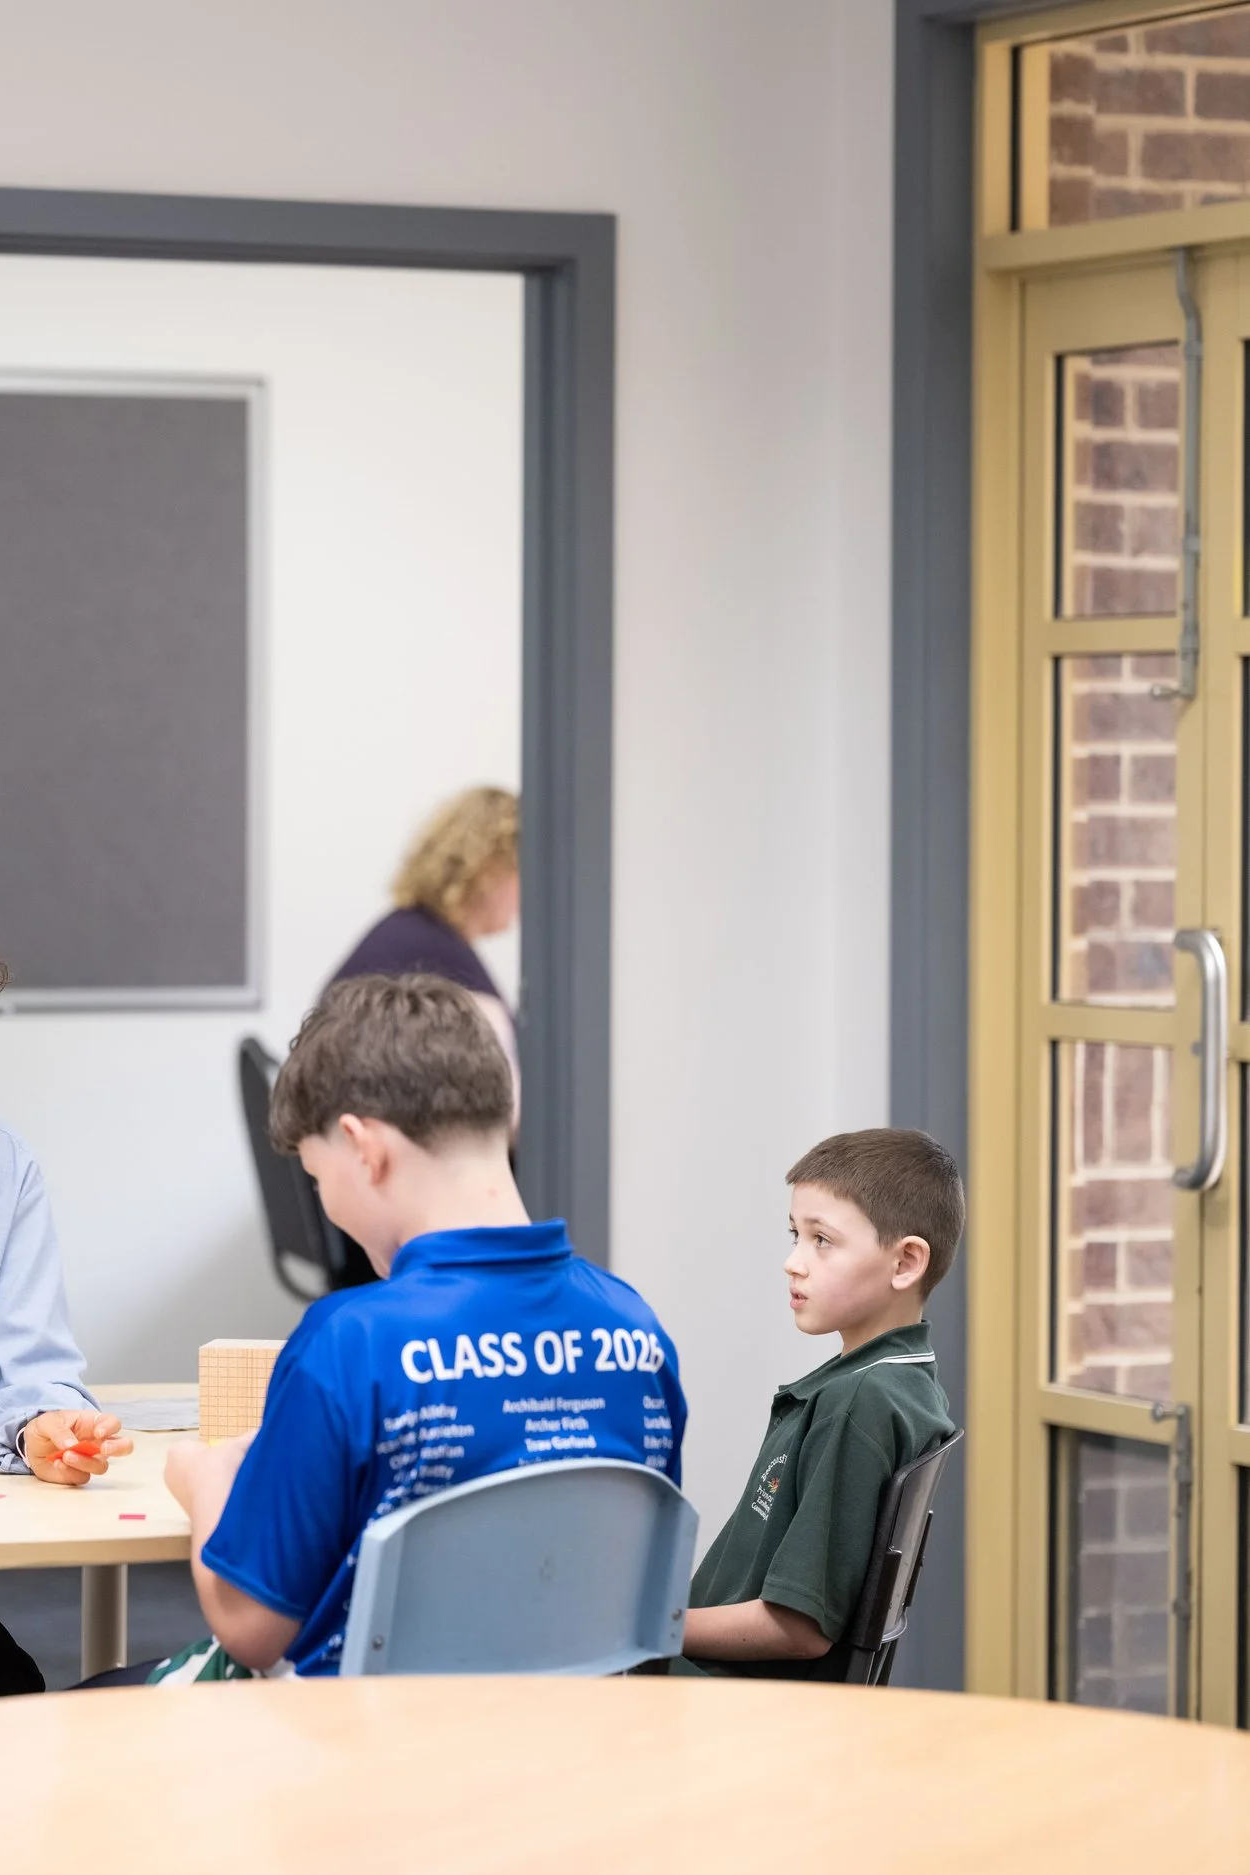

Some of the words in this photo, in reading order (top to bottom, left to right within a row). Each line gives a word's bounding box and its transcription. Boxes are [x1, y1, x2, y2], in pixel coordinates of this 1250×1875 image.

[400, 1331, 527, 1384] CLASS
[533, 1330, 583, 1375] OF
[556, 1396, 606, 1414] Ferguson
